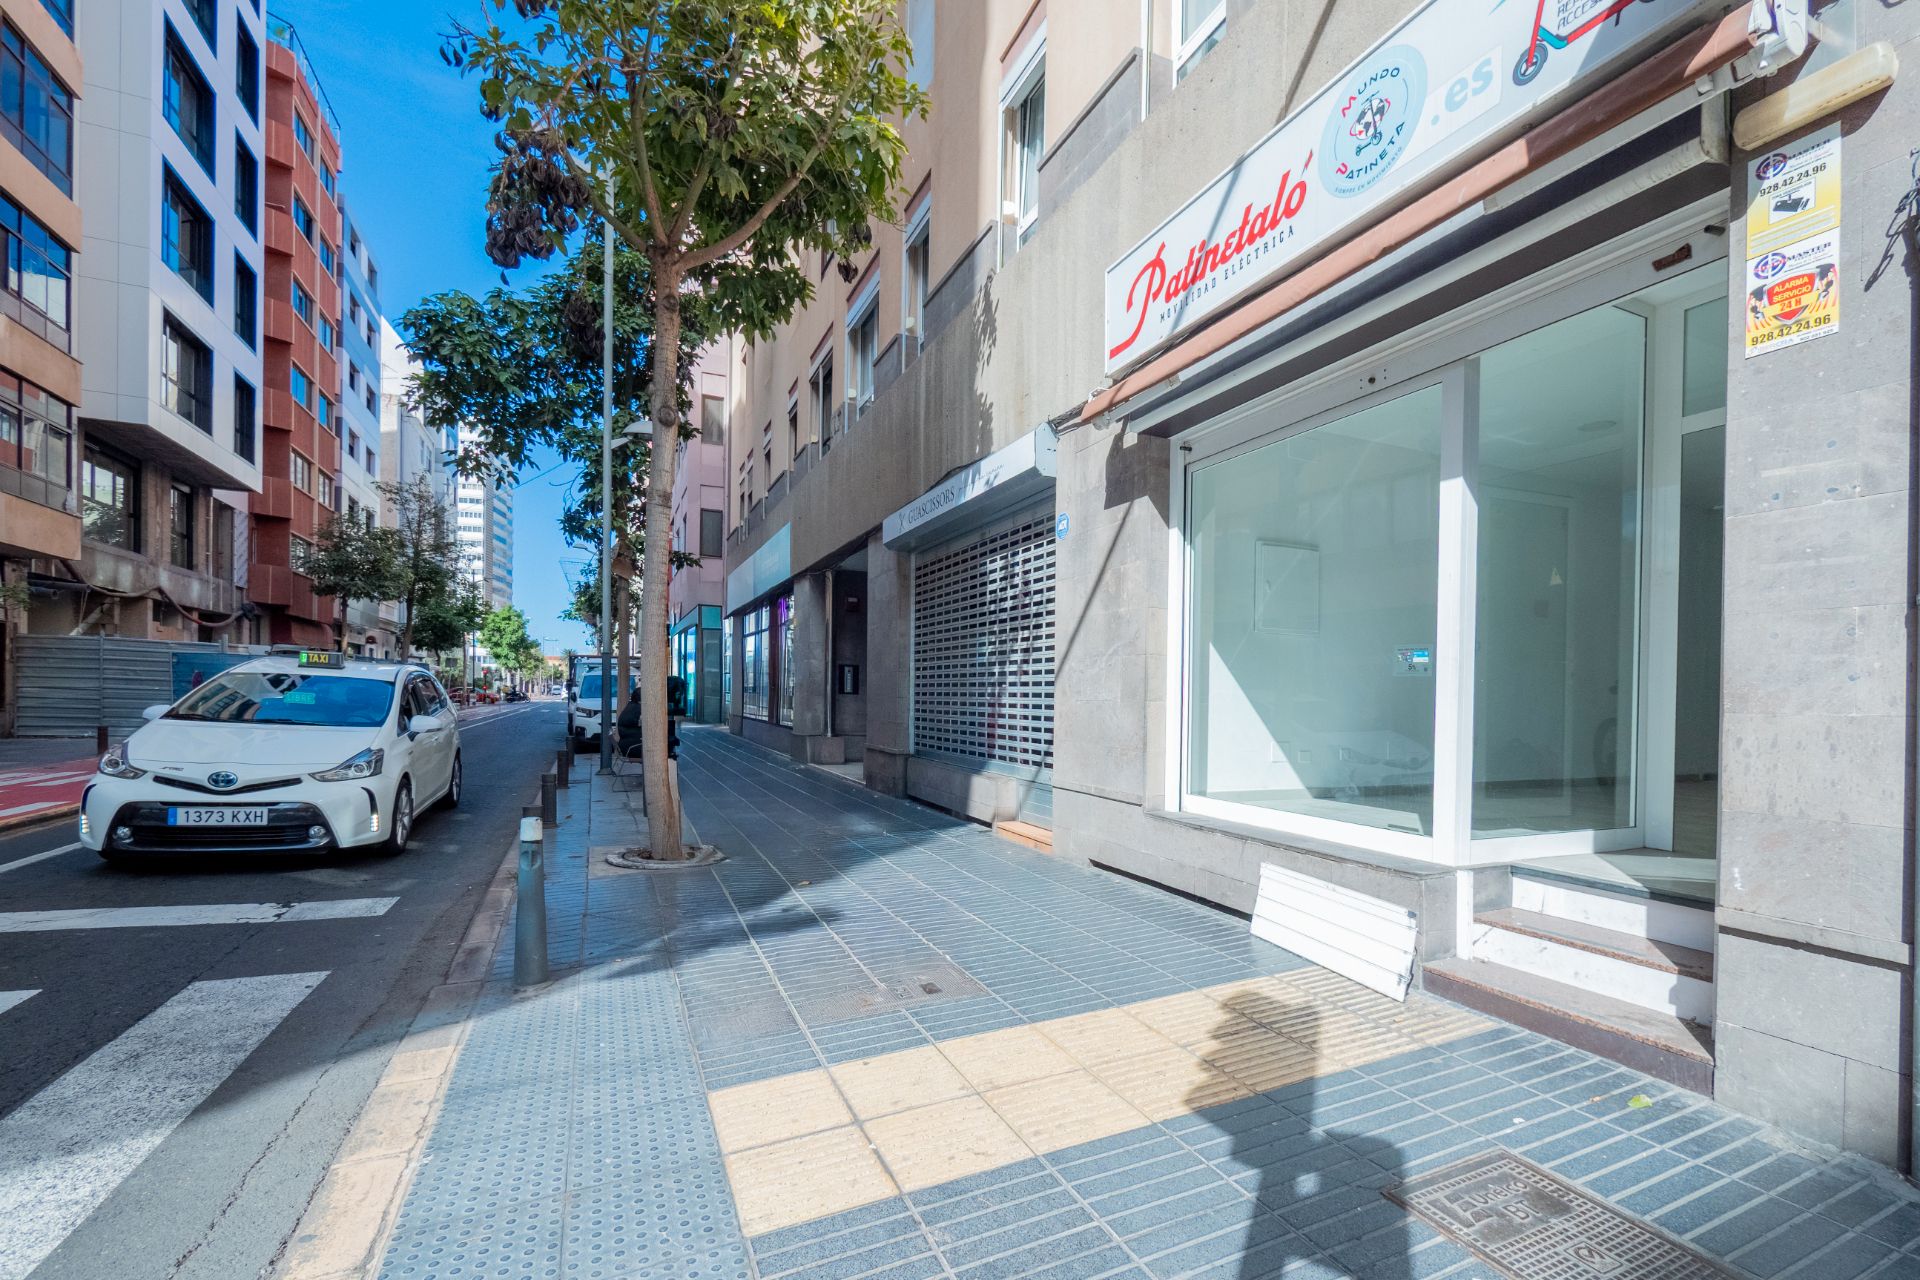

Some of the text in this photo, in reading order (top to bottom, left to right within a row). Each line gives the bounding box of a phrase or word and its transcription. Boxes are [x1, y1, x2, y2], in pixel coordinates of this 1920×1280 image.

[1341, 66, 1401, 118] MUNDO
[1760, 162, 1827, 197] 928.42.24.96
[1159, 225, 1295, 323] MOVILIDAD ELÉCTRICA
[1773, 276, 1809, 294] ALARMA
[1773, 285, 1812, 303] SERVICIO
[1780, 297, 1802, 312] 24 H
[1751, 314, 1831, 346] 928.42.24.96
[308, 653, 329, 664] TAXI
[184, 810, 264, 823] 1373 KXH
[1469, 1180, 1529, 1206] Unelco
[1502, 1199, 1540, 1221] BT
